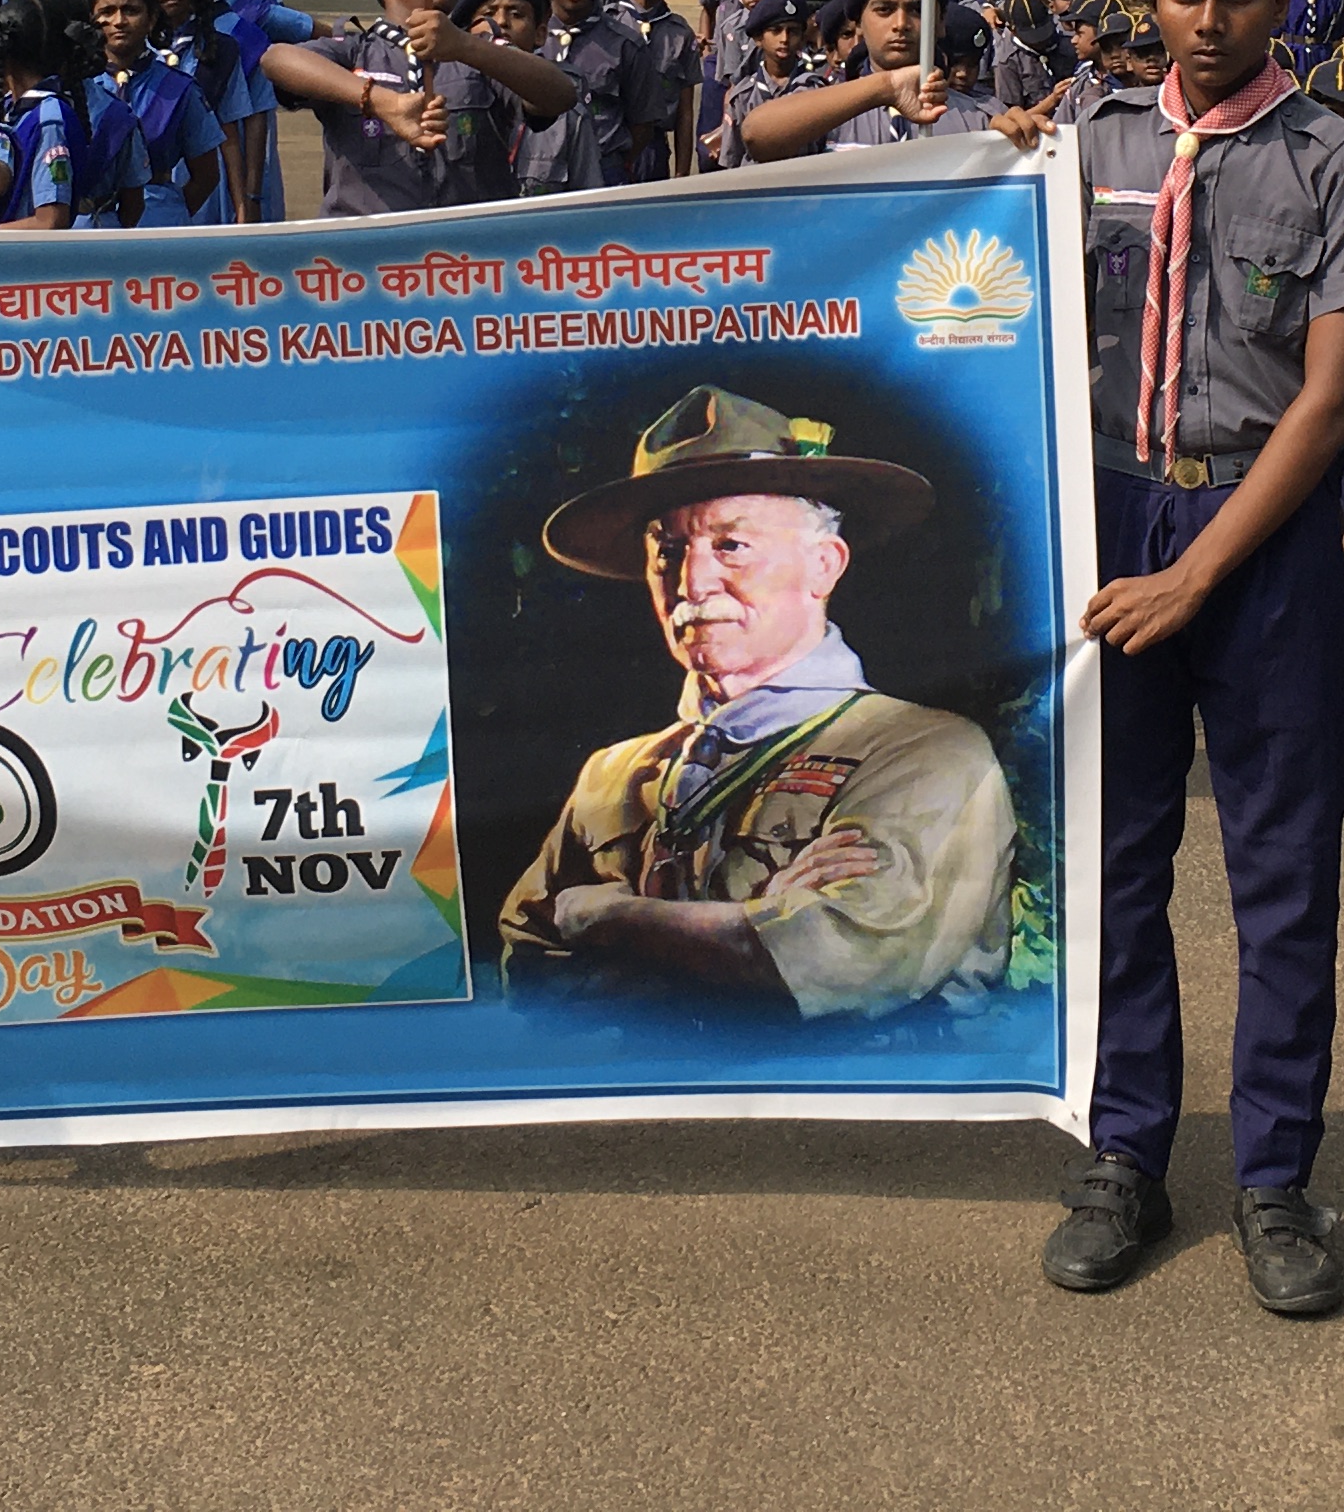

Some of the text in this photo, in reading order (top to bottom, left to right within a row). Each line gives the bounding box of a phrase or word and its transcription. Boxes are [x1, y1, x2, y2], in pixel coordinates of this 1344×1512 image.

[377, 251, 506, 298] कलिंग
[202, 327, 269, 366] INS
[281, 317, 462, 361] KALINGA
[474, 298, 860, 351] BHEEMUNIPATNAM
[143, 516, 229, 567] AND
[239, 506, 393, 562] GUIDES
[253, 782, 365, 842] 7th
[242, 849, 402, 896] NOV
